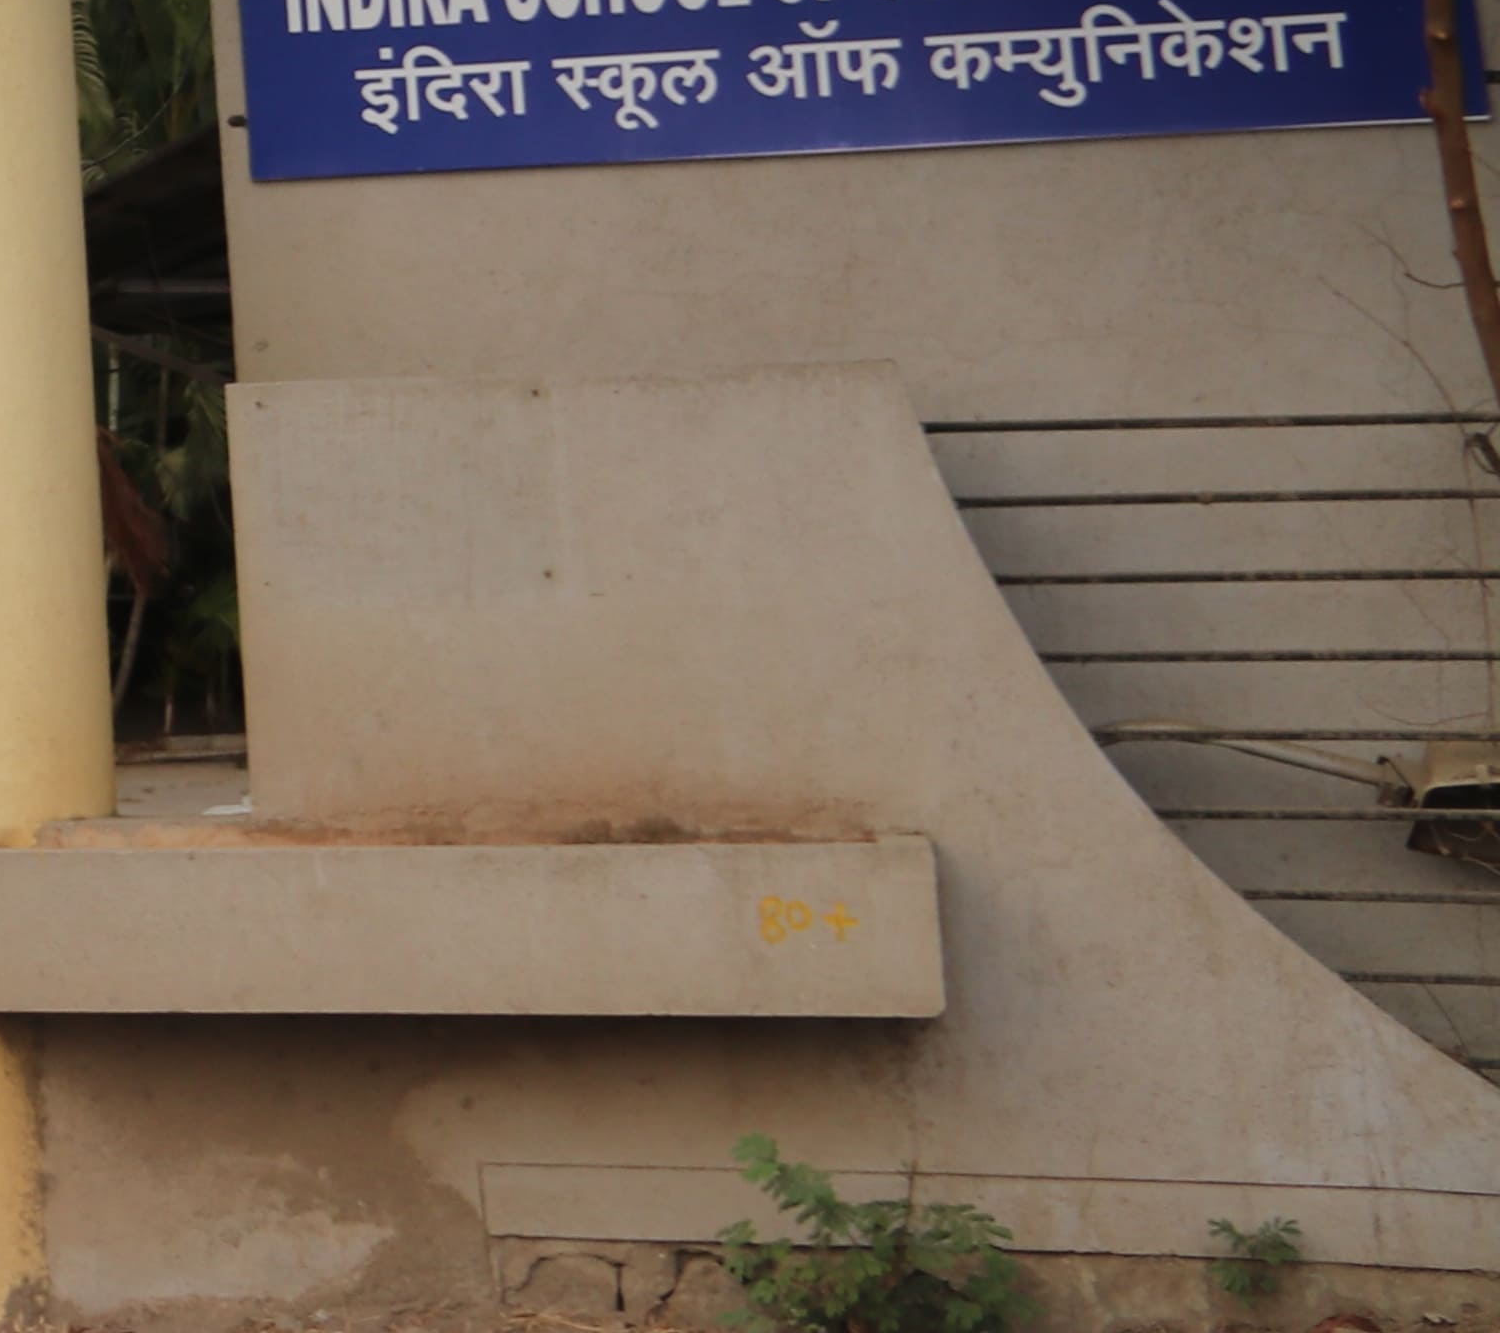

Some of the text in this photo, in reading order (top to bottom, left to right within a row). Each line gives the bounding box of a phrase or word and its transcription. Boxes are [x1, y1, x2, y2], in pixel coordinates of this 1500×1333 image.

[354, 44, 532, 134] इंदिरा
[551, 48, 721, 130] स्कूल
[746, 19, 902, 99] ऑफ
